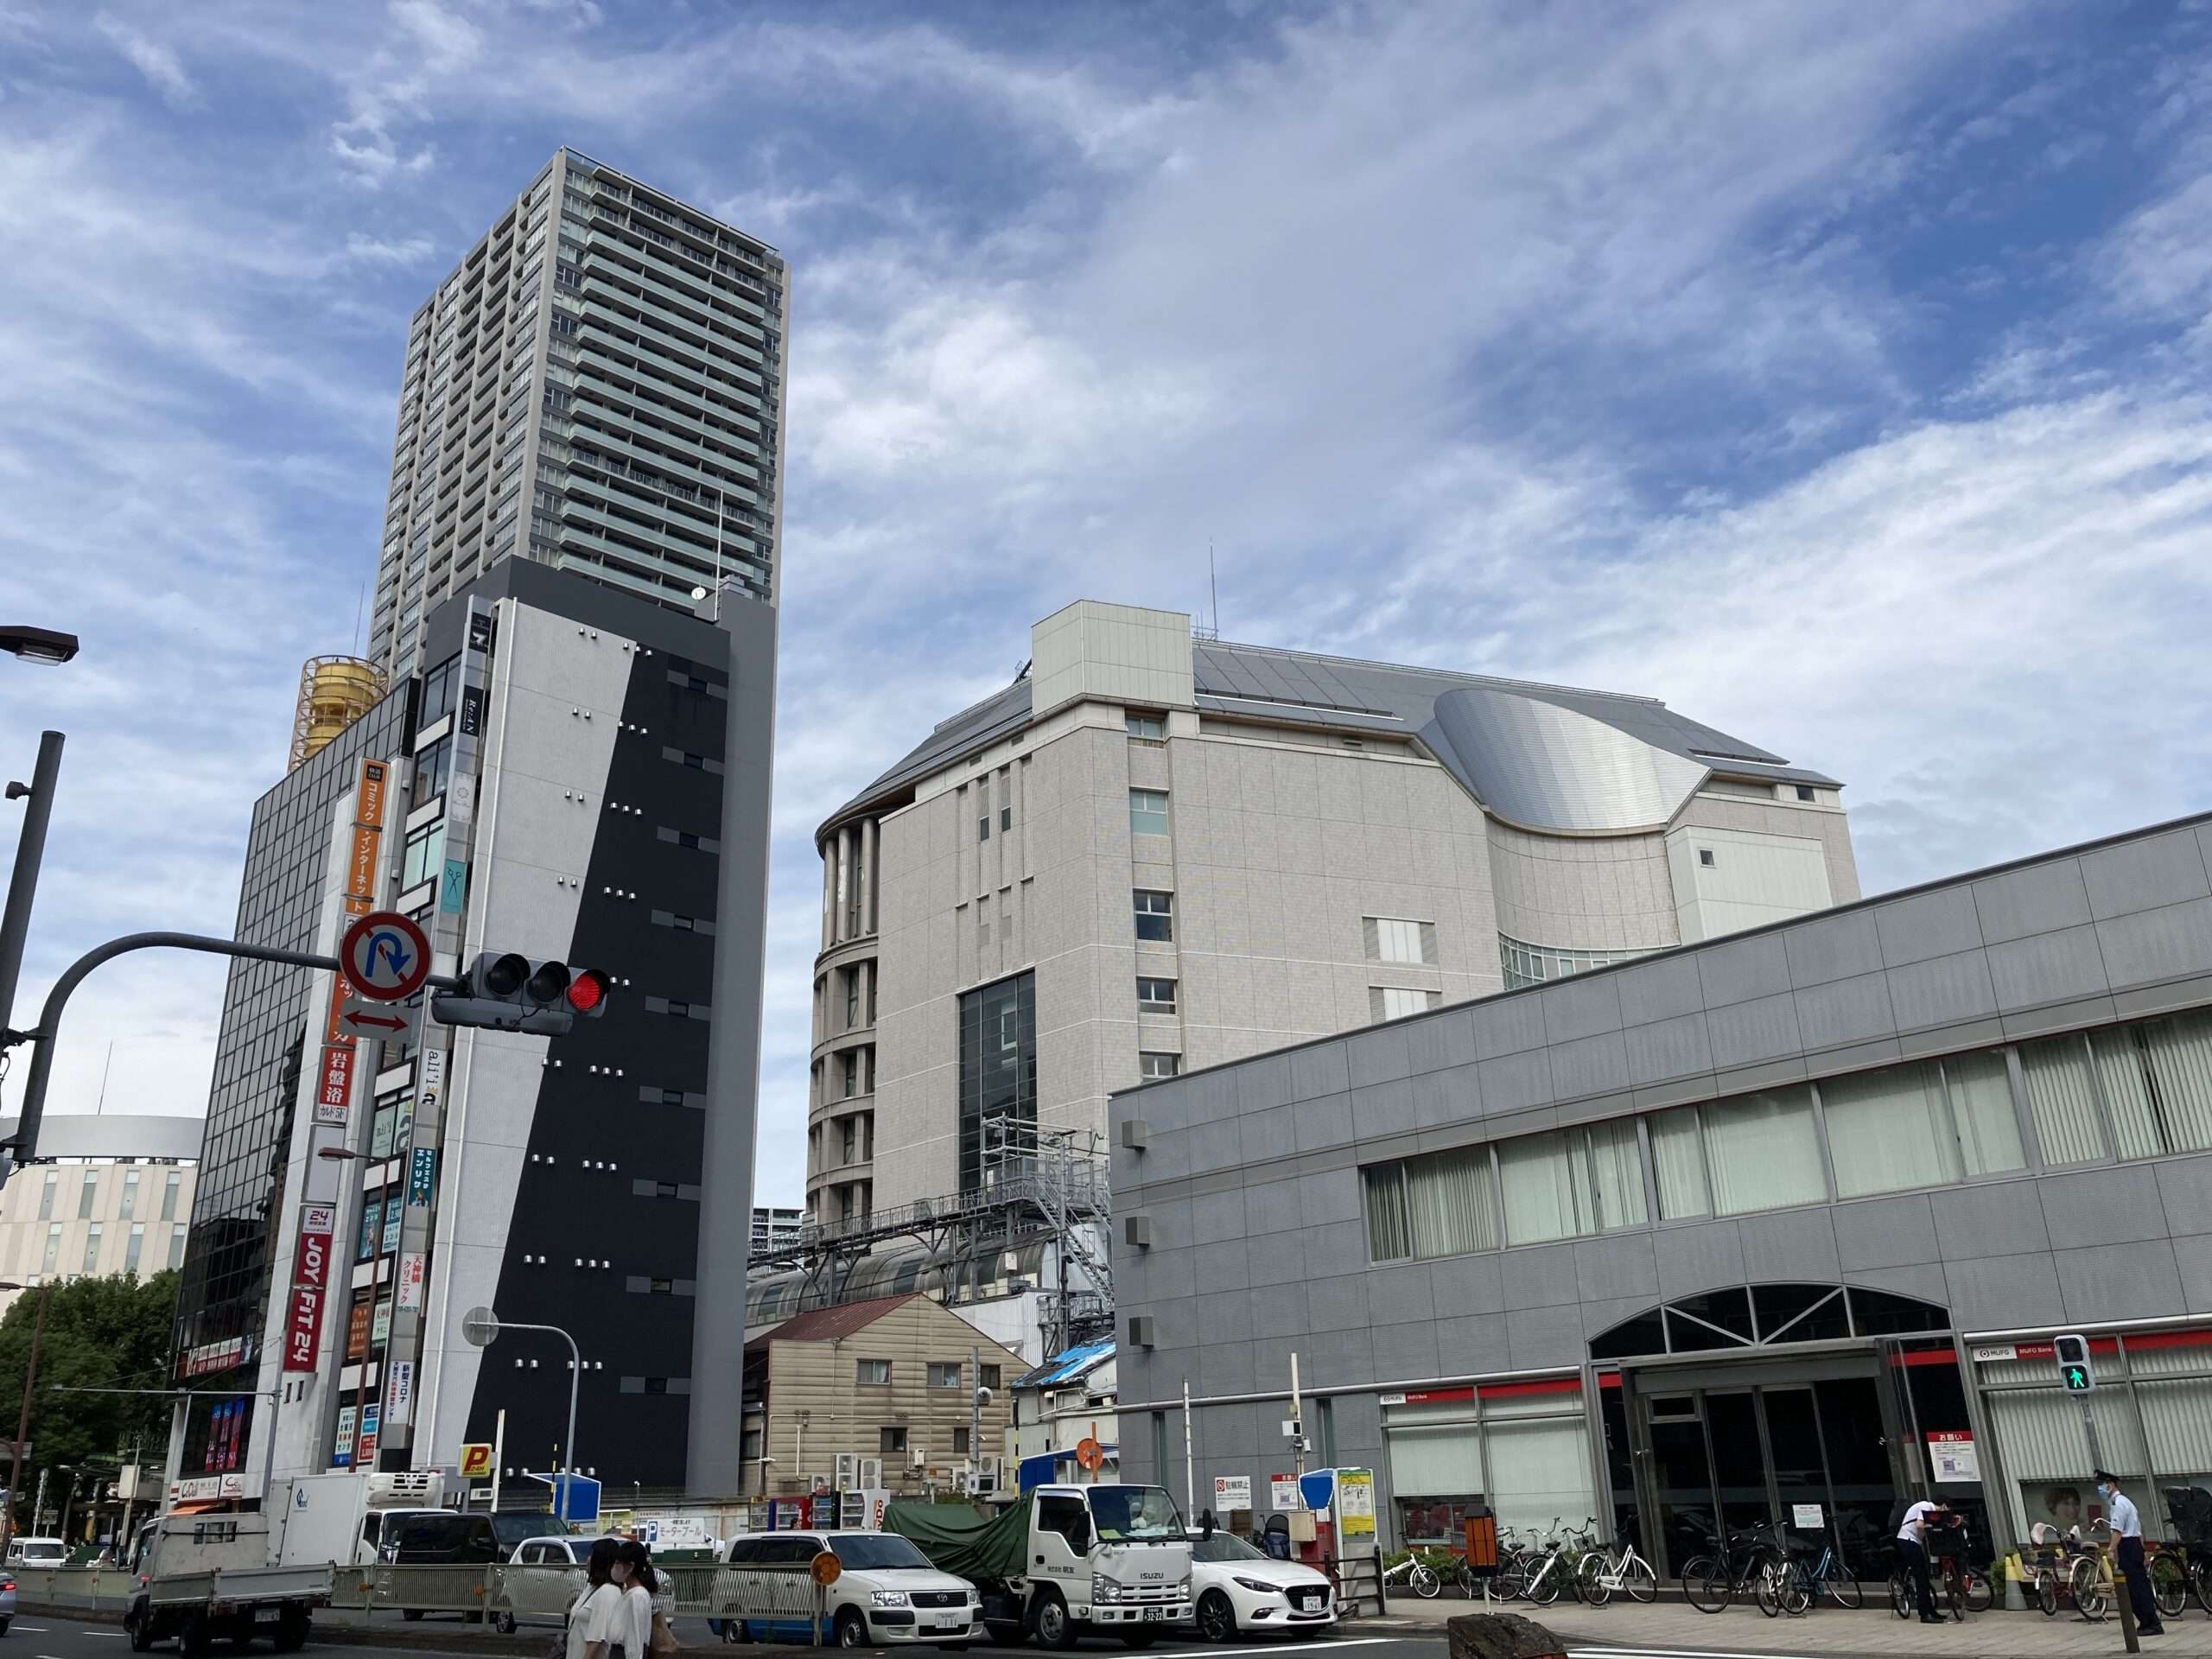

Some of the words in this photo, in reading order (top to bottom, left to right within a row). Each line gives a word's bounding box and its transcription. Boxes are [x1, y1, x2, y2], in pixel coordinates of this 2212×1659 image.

[327, 1052, 347, 1103] 岩盤浴
[309, 1211, 328, 1220] 24
[400, 1261, 411, 1305] クリニック
[399, 1364, 410, 1404] 新型コロナ
[463, 1446, 489, 1471] P
